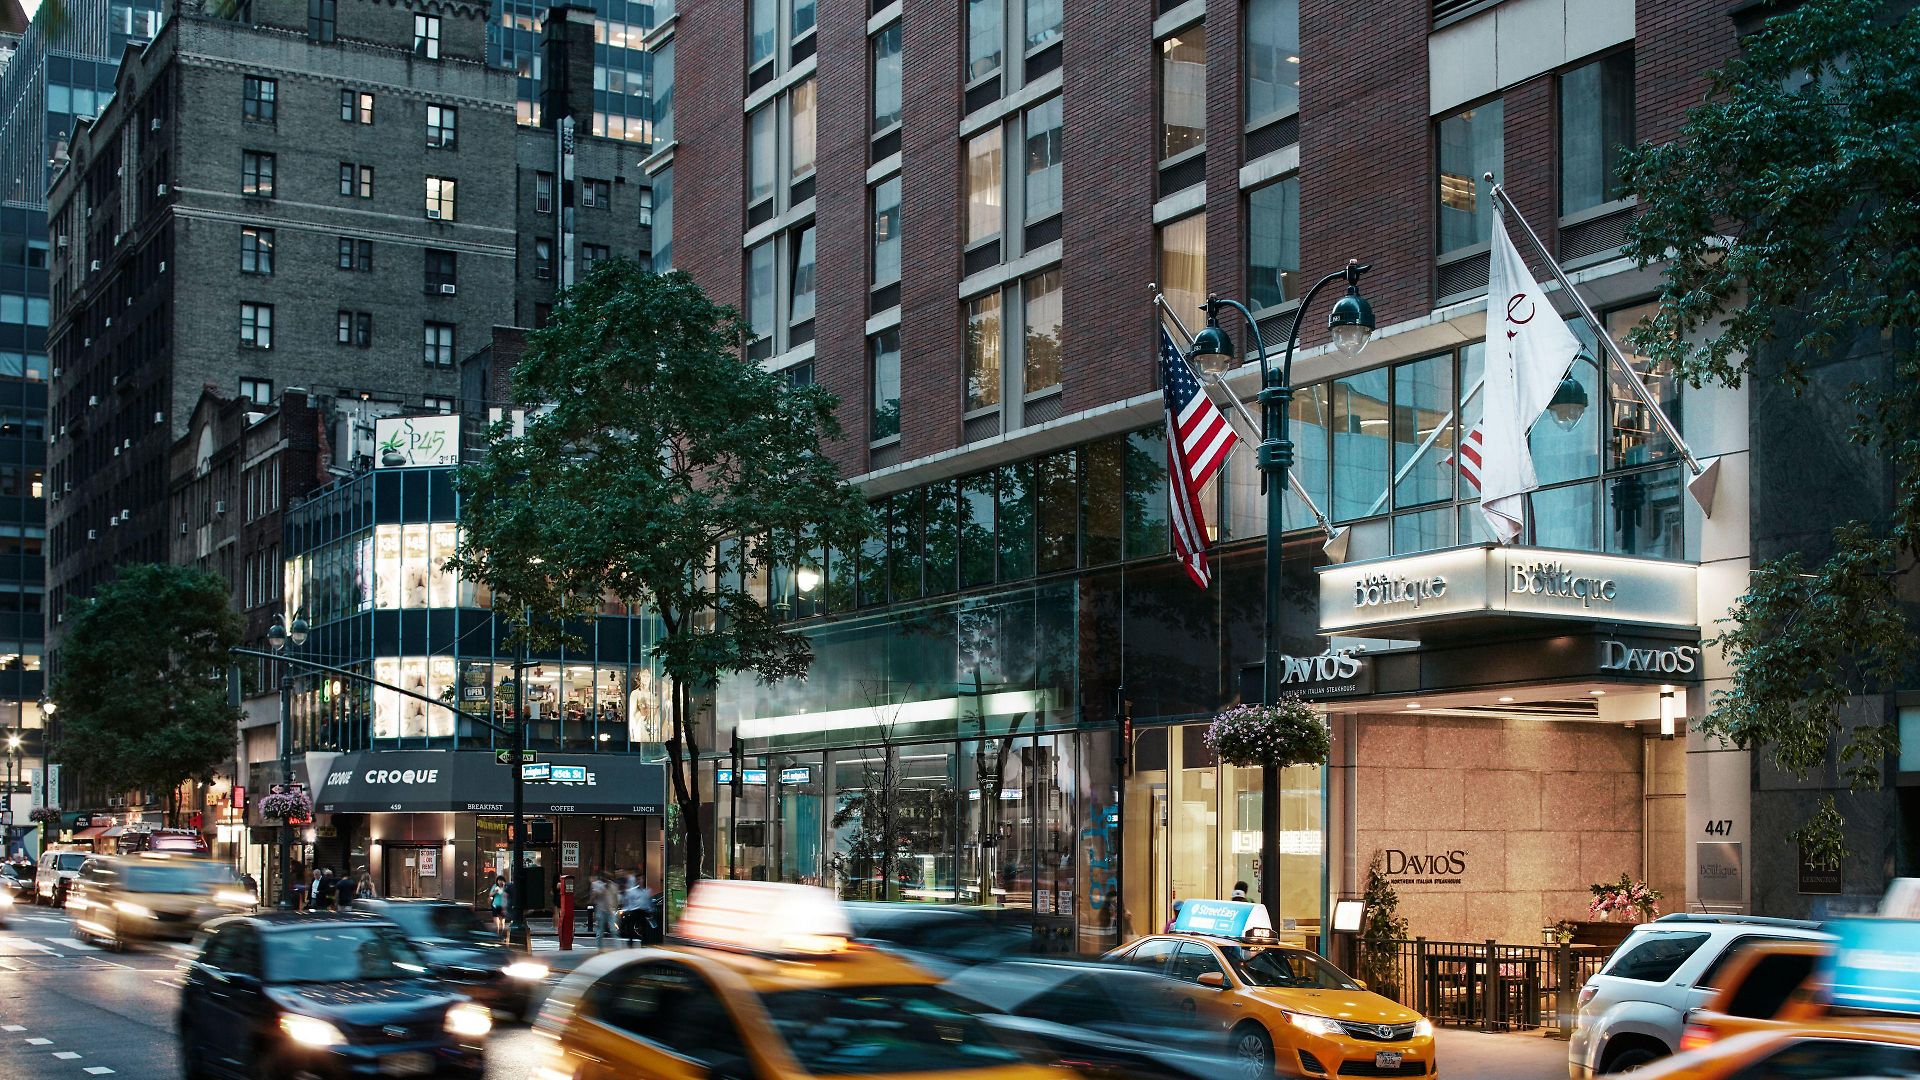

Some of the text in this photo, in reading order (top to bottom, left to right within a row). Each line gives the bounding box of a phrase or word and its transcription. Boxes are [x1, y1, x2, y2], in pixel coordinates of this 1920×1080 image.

[417, 430, 445, 459] 45
[450, 454, 459, 464] FL
[1353, 575, 1447, 609] Boutique
[1511, 564, 1617, 608] Boutique
[467, 688, 483, 696] OPEN
[1307, 687, 1325, 695] ITALIAN
[1326, 684, 1356, 693] STEAKHOUSE
[327, 771, 353, 785] CROQUE
[365, 769, 438, 785] CROQUE
[572, 769, 582, 779] St
[390, 803, 402, 811] 459
[467, 803, 503, 811] BREAKFAST
[1704, 820, 1733, 836] 447
[1385, 849, 1466, 875] DAVIO'S
[1199, 904, 1239, 919] StreetEasy
